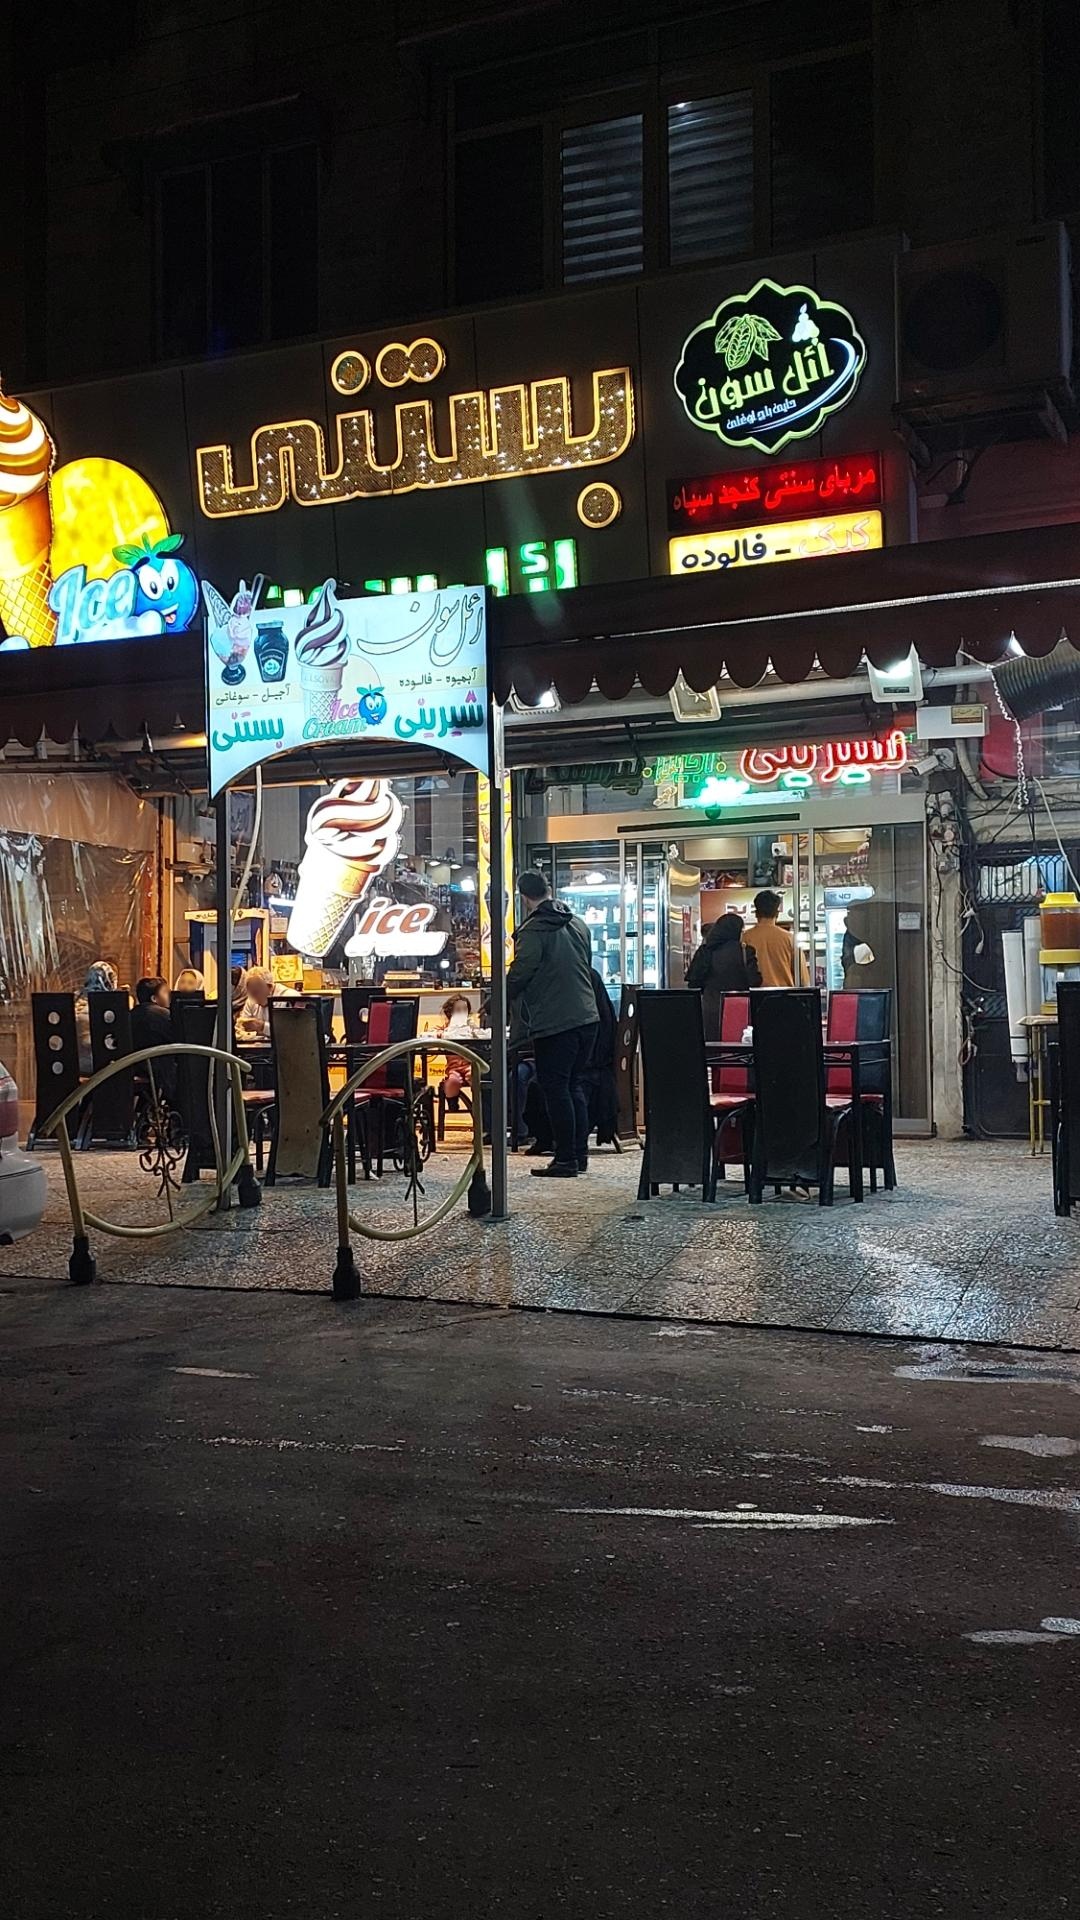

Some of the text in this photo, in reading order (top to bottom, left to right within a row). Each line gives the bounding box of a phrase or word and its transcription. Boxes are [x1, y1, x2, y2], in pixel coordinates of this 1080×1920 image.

[695, 368, 776, 420] سون
[196, 337, 637, 528] بستنی
[673, 465, 876, 516] مربای سنتی کنجد سیاه
[681, 533, 767, 569] فالوده
[49, 565, 138, 641] Ice
[261, 683, 291, 703] آجیل
[399, 672, 432, 691] فالوده
[446, 667, 478, 687] آبمیوه
[215, 690, 249, 706] سوغاتی
[329, 698, 359, 721] Ice
[394, 690, 484, 738] شیرینی
[212, 711, 285, 752] بستنی
[302, 717, 368, 740] Cream
[359, 901, 430, 934] ice
